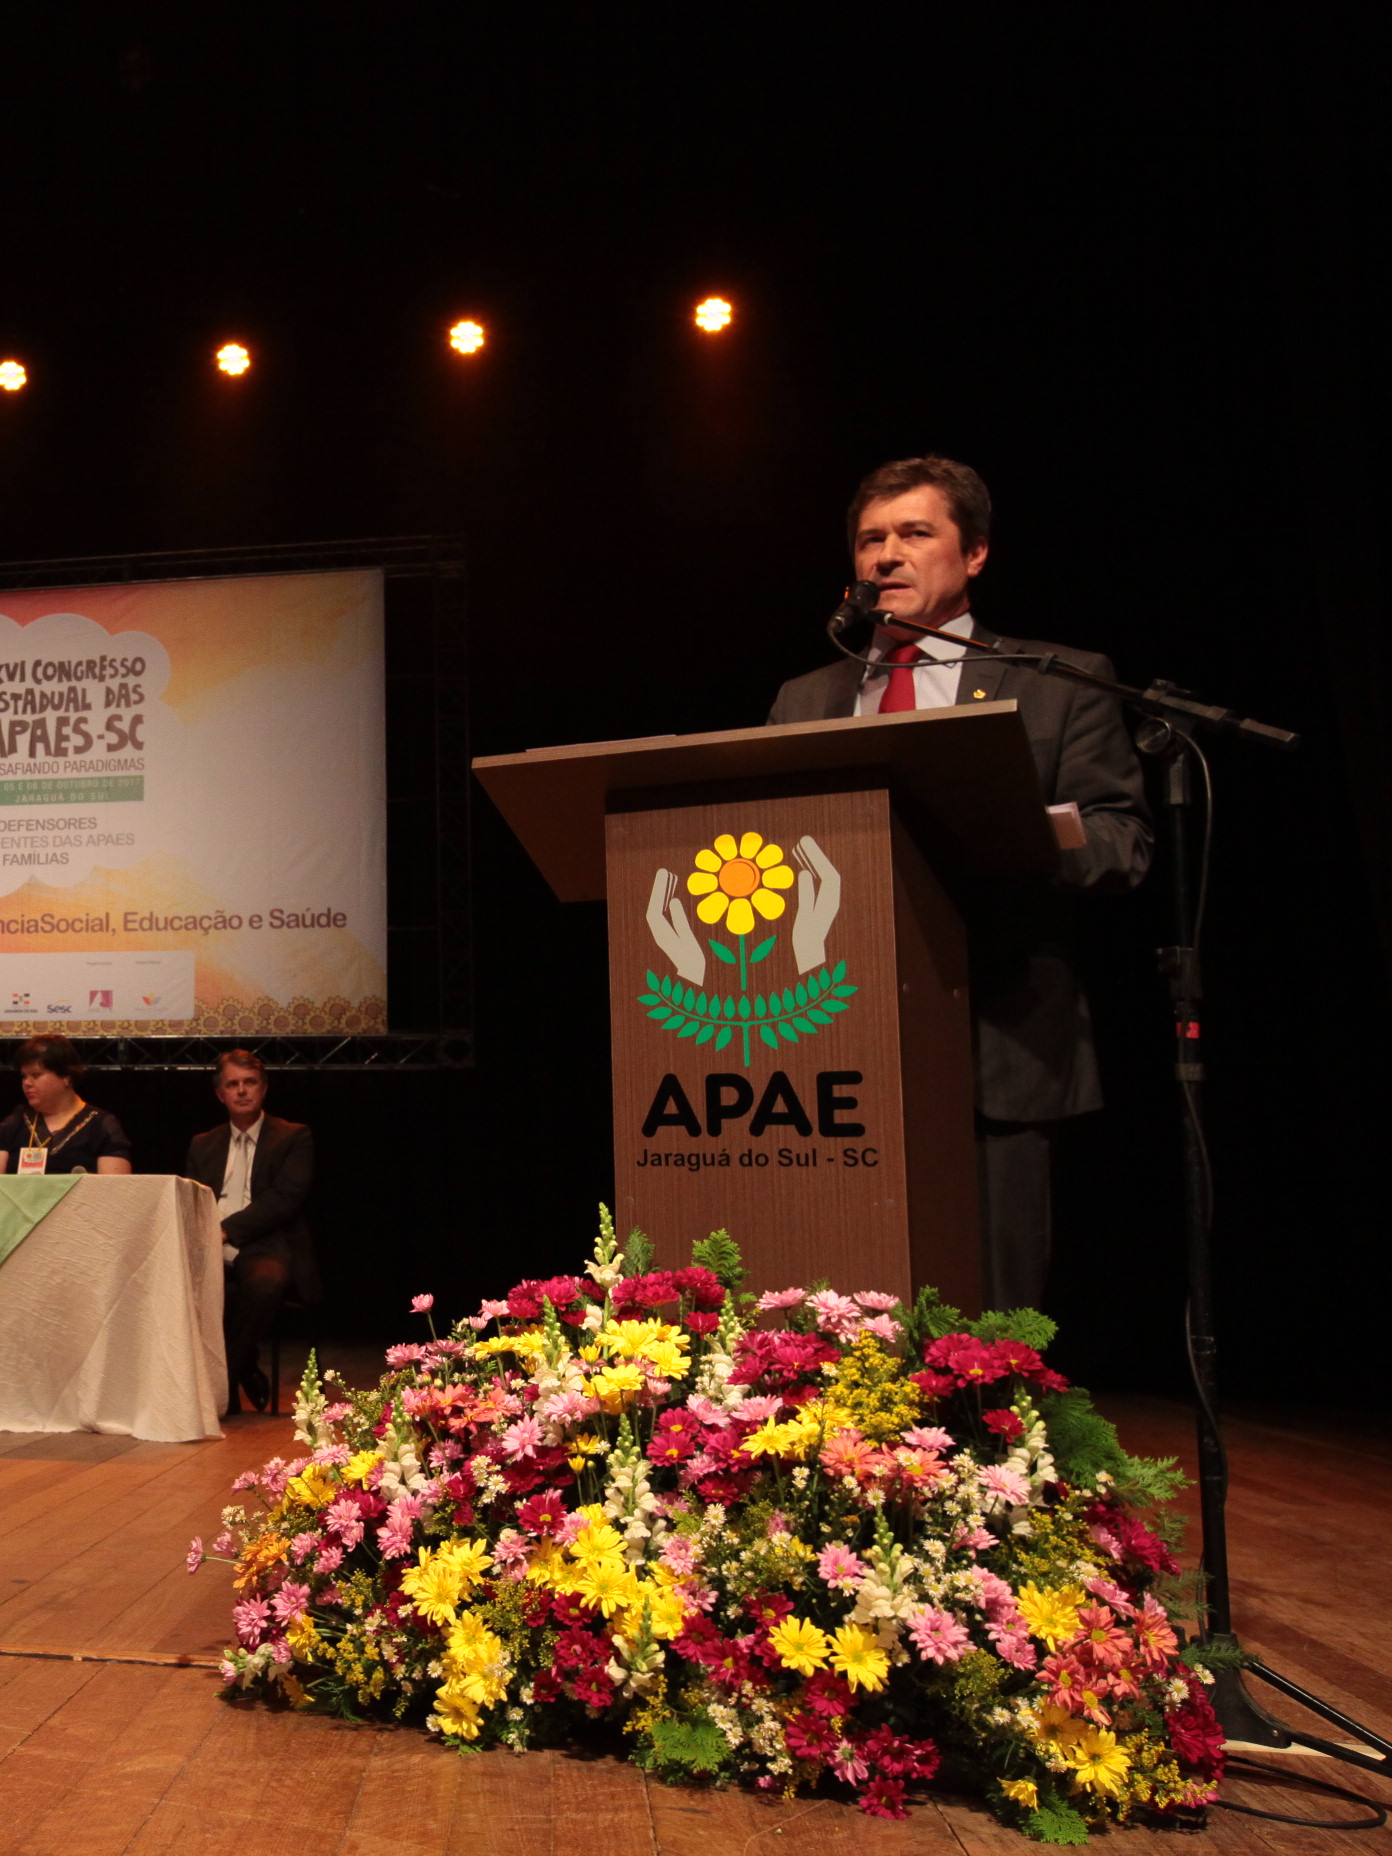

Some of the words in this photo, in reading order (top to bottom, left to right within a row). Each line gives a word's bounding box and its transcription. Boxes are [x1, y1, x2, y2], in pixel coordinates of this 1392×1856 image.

[31, 655, 146, 685] CONGRESSO
[104, 682, 145, 709] DAS
[63, 757, 145, 774] PARADIGMAS
[41, 781, 53, 790] DE
[57, 780, 99, 789] OUTUBRO
[102, 779, 115, 788] DE
[70, 793, 85, 801] DO
[52, 834, 83, 848] DAS
[85, 832, 136, 847] APAES
[2, 850, 70, 866] FAMÍLIAS
[122, 910, 244, 936] Educação
[248, 914, 264, 930] e
[268, 907, 348, 930] Saúde
[47, 1004, 72, 1013] Sesc
[641, 1070, 866, 1138] APAE
[636, 1148, 731, 1172] Jaraguá
[738, 1149, 770, 1167] do
[777, 1148, 818, 1168] Sul
[842, 1148, 880, 1168] SC
